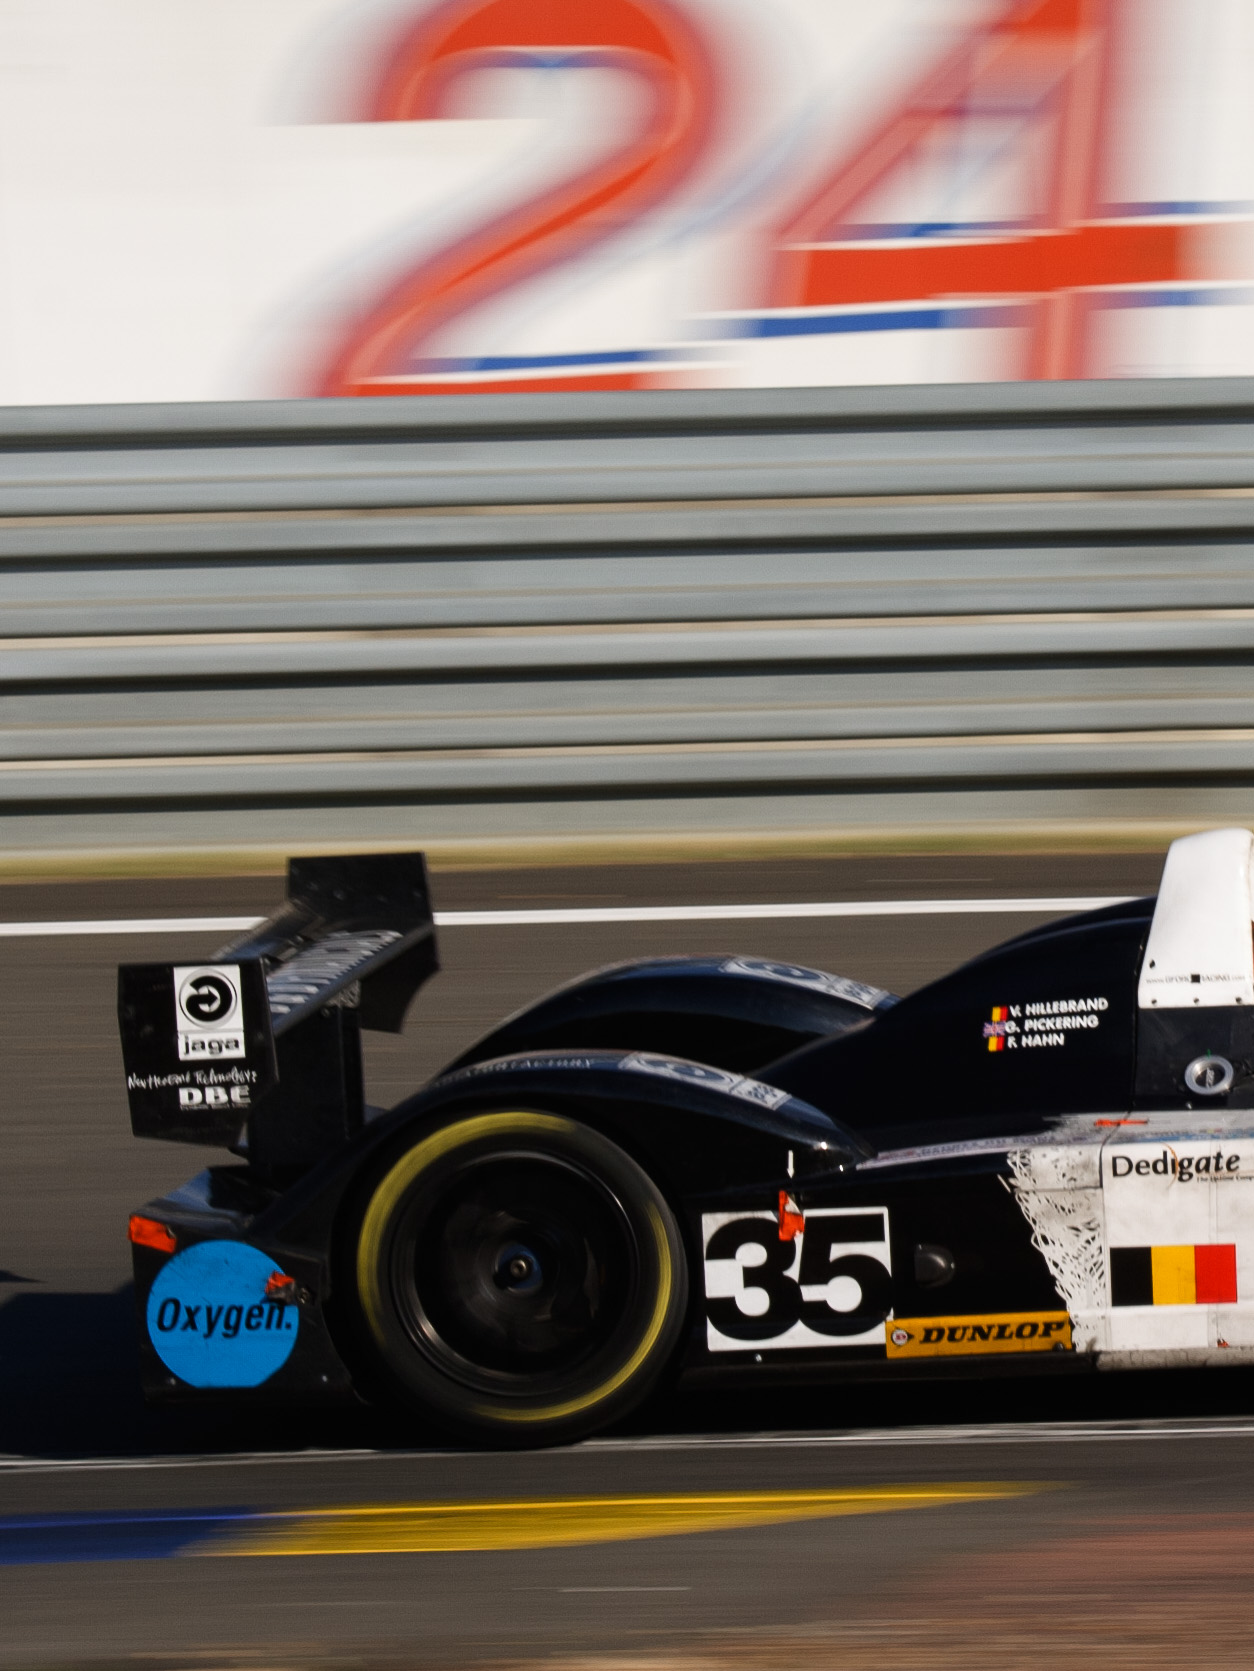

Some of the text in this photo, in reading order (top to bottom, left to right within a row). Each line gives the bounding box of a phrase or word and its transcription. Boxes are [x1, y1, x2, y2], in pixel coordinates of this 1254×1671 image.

[300, 0, 1190, 398] 24
[1025, 997, 1109, 1016] HILLEBRAND
[1024, 1014, 1099, 1032] PICKERING
[184, 1033, 239, 1055] jaga
[1021, 1032, 1065, 1048] HAHN
[179, 1084, 251, 1106] DBE
[1112, 1149, 1241, 1182] Dedigate
[705, 1213, 893, 1341] 35
[157, 1297, 292, 1339] Oxygen.
[920, 1321, 1066, 1344] DUNLOP
